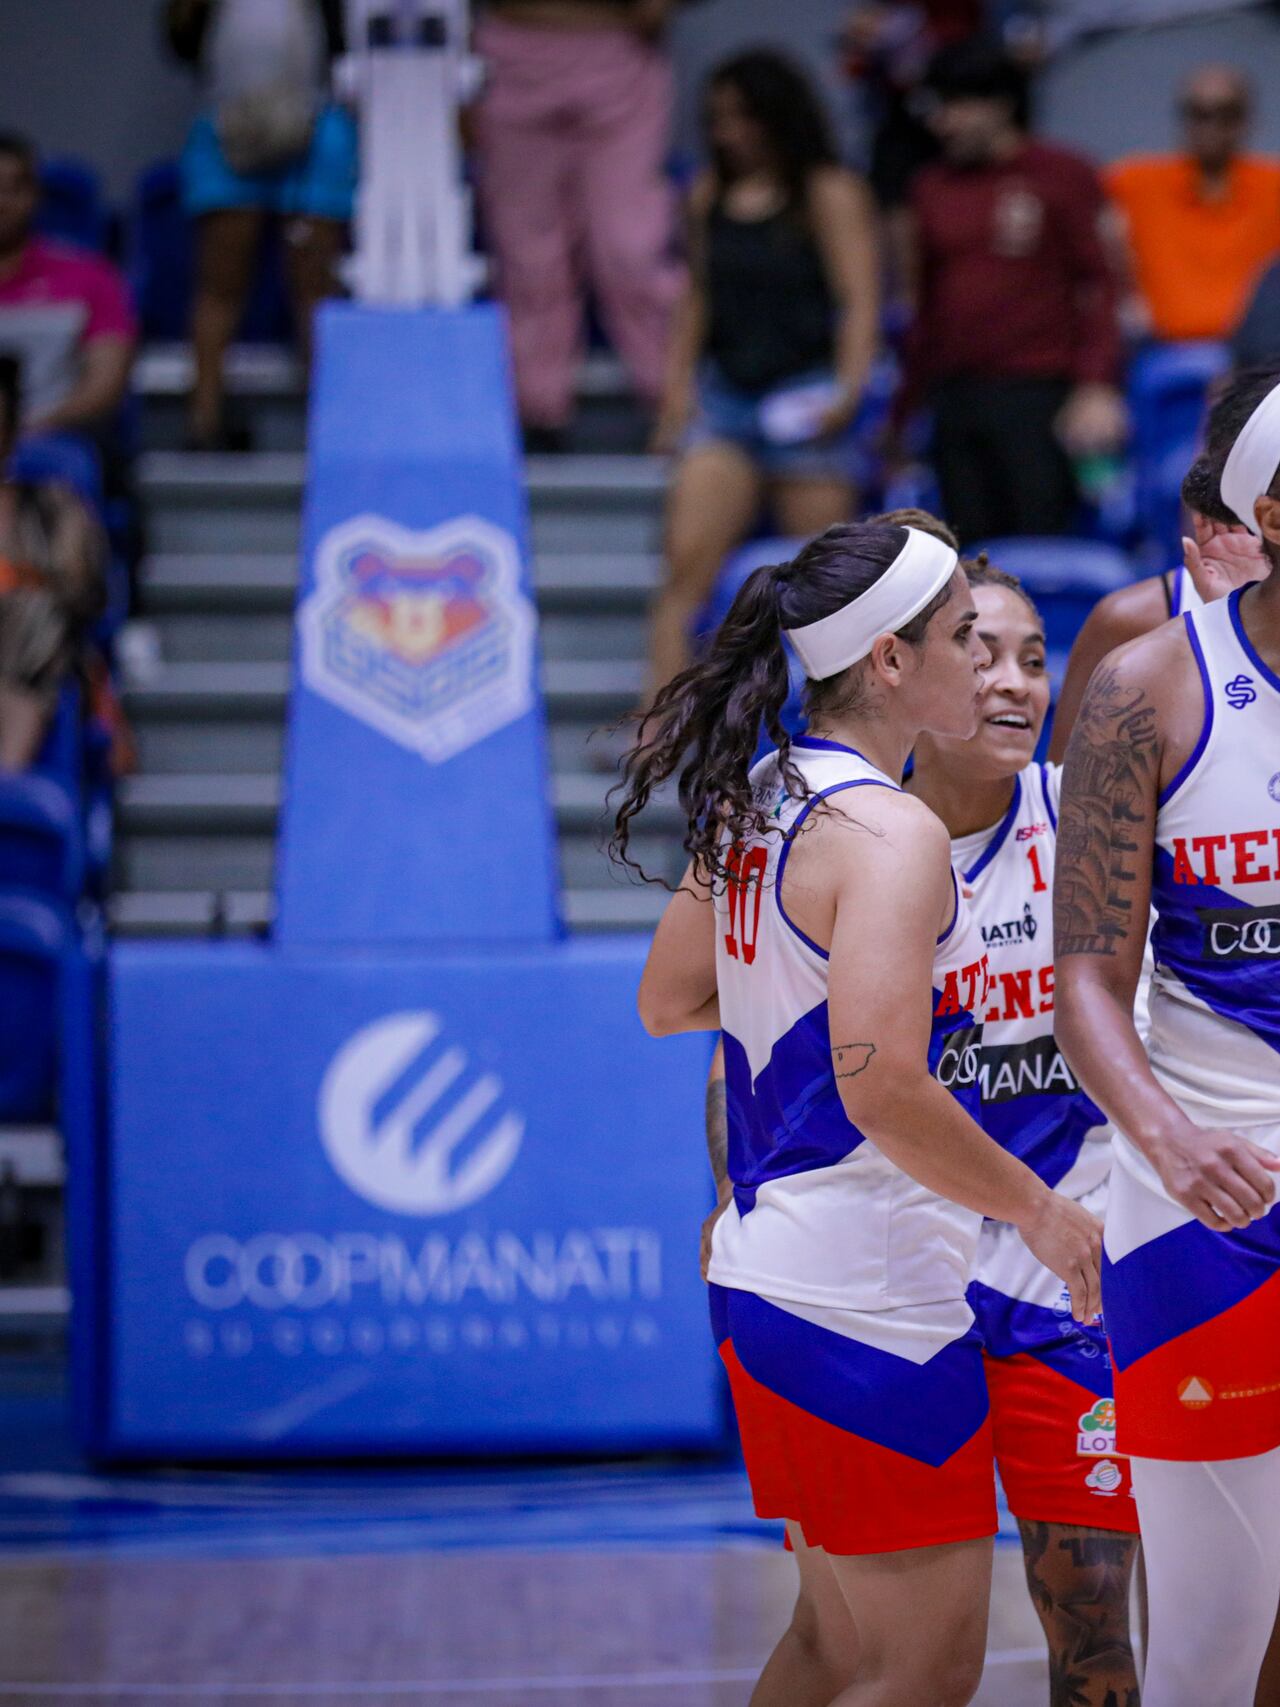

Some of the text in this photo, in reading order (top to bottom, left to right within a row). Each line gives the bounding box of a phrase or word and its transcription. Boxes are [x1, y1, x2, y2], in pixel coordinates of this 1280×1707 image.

[724, 841, 768, 965] 10
[1027, 845, 1047, 892] 1
[186, 1230, 661, 1309] COOPMANATI
